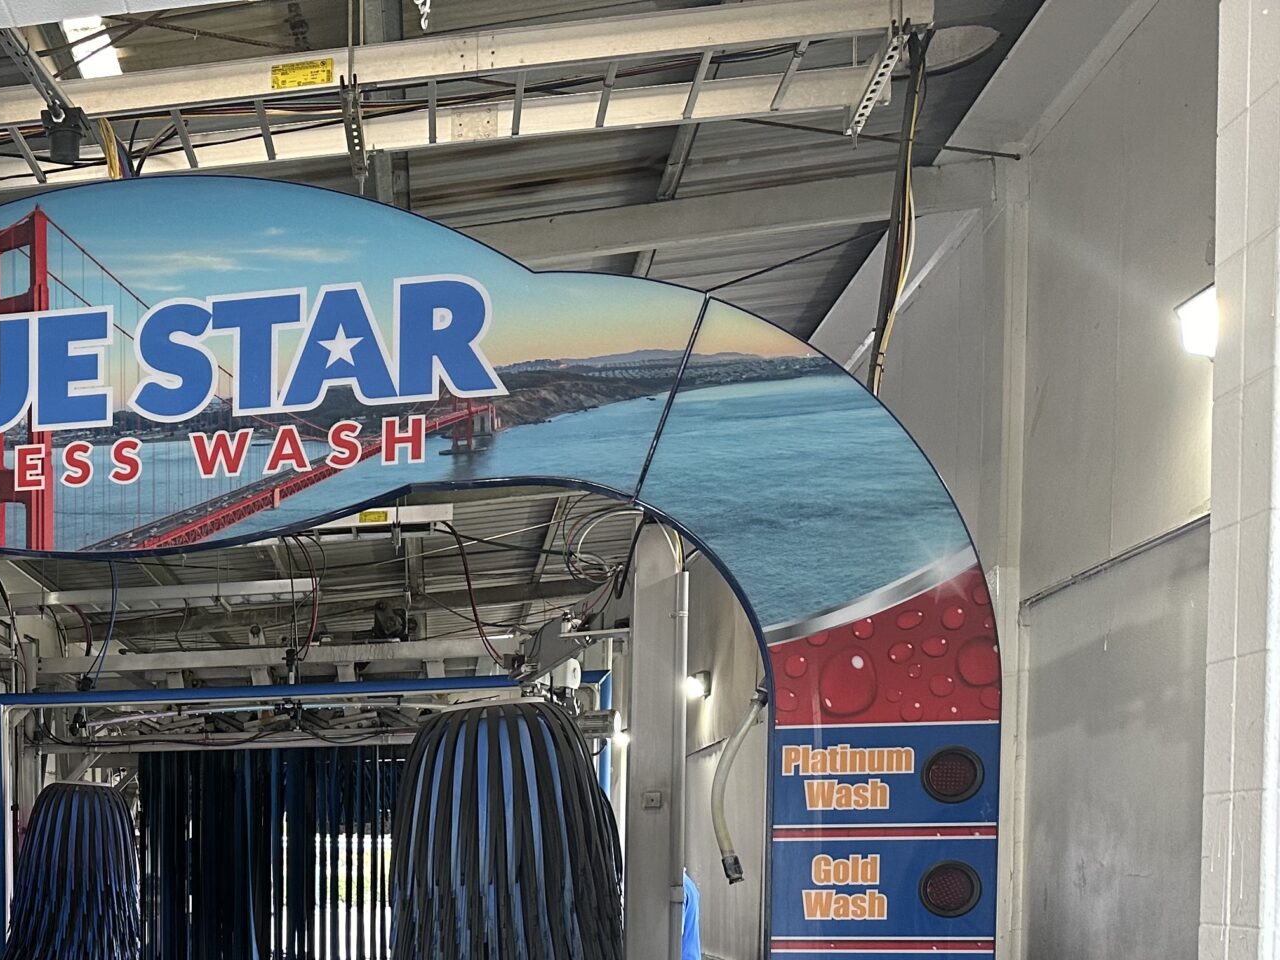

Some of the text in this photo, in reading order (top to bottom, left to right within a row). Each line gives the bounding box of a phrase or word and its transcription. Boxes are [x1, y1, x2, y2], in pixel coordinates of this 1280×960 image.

[129, 273, 510, 423] STAR
[189, 414, 427, 479] WASH
[782, 743, 915, 776] Platinum
[804, 778, 890, 811] Wash
[811, 854, 880, 886] Gold
[802, 889, 888, 921] Wash
